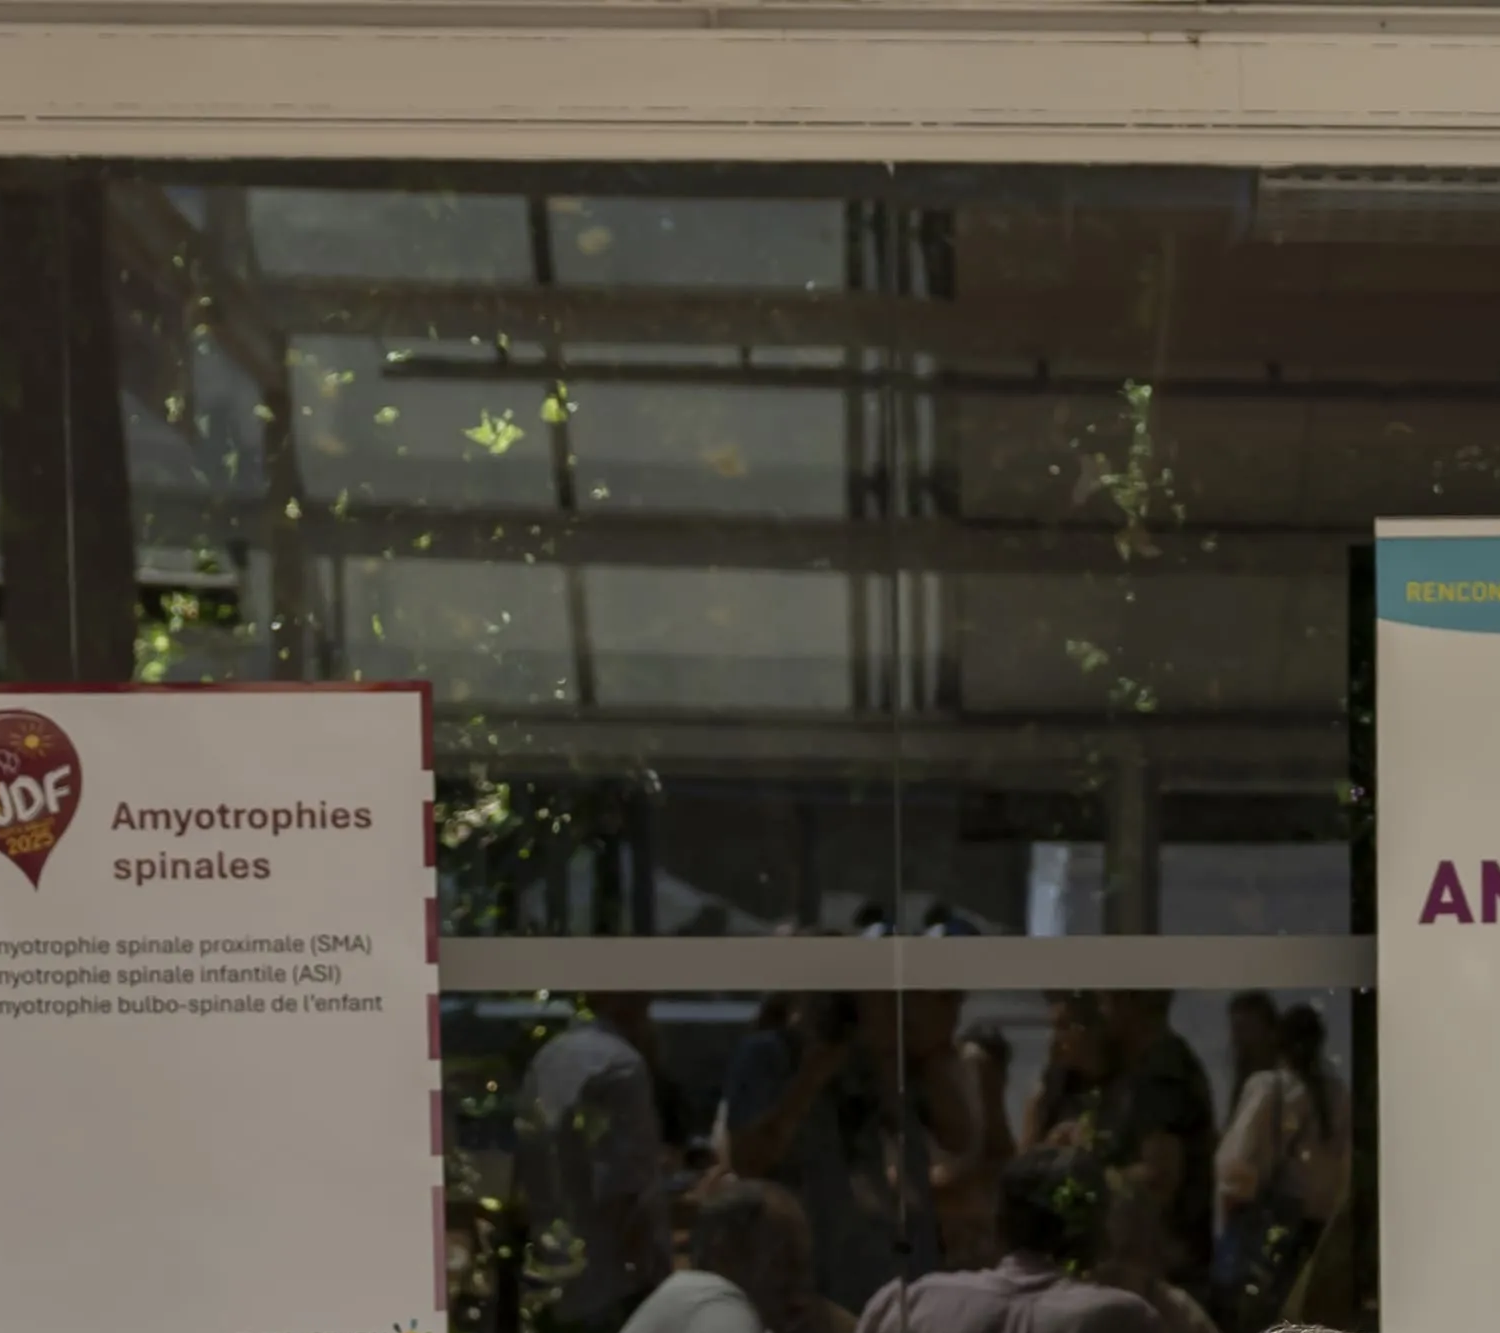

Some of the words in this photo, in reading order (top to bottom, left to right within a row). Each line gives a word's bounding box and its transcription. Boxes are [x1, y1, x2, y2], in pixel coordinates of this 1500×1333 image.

[111, 800, 373, 838] Amyotrophies
[112, 850, 272, 887] spinales
[116, 935, 195, 958] spinale
[200, 934, 306, 958] proximale
[310, 934, 373, 956] (SMA)
[117, 965, 195, 987] spinale
[201, 965, 287, 983] infantile
[292, 964, 342, 985] (ASI)
[117, 995, 266, 1017] bulbo-spinale
[270, 995, 299, 1013] de
